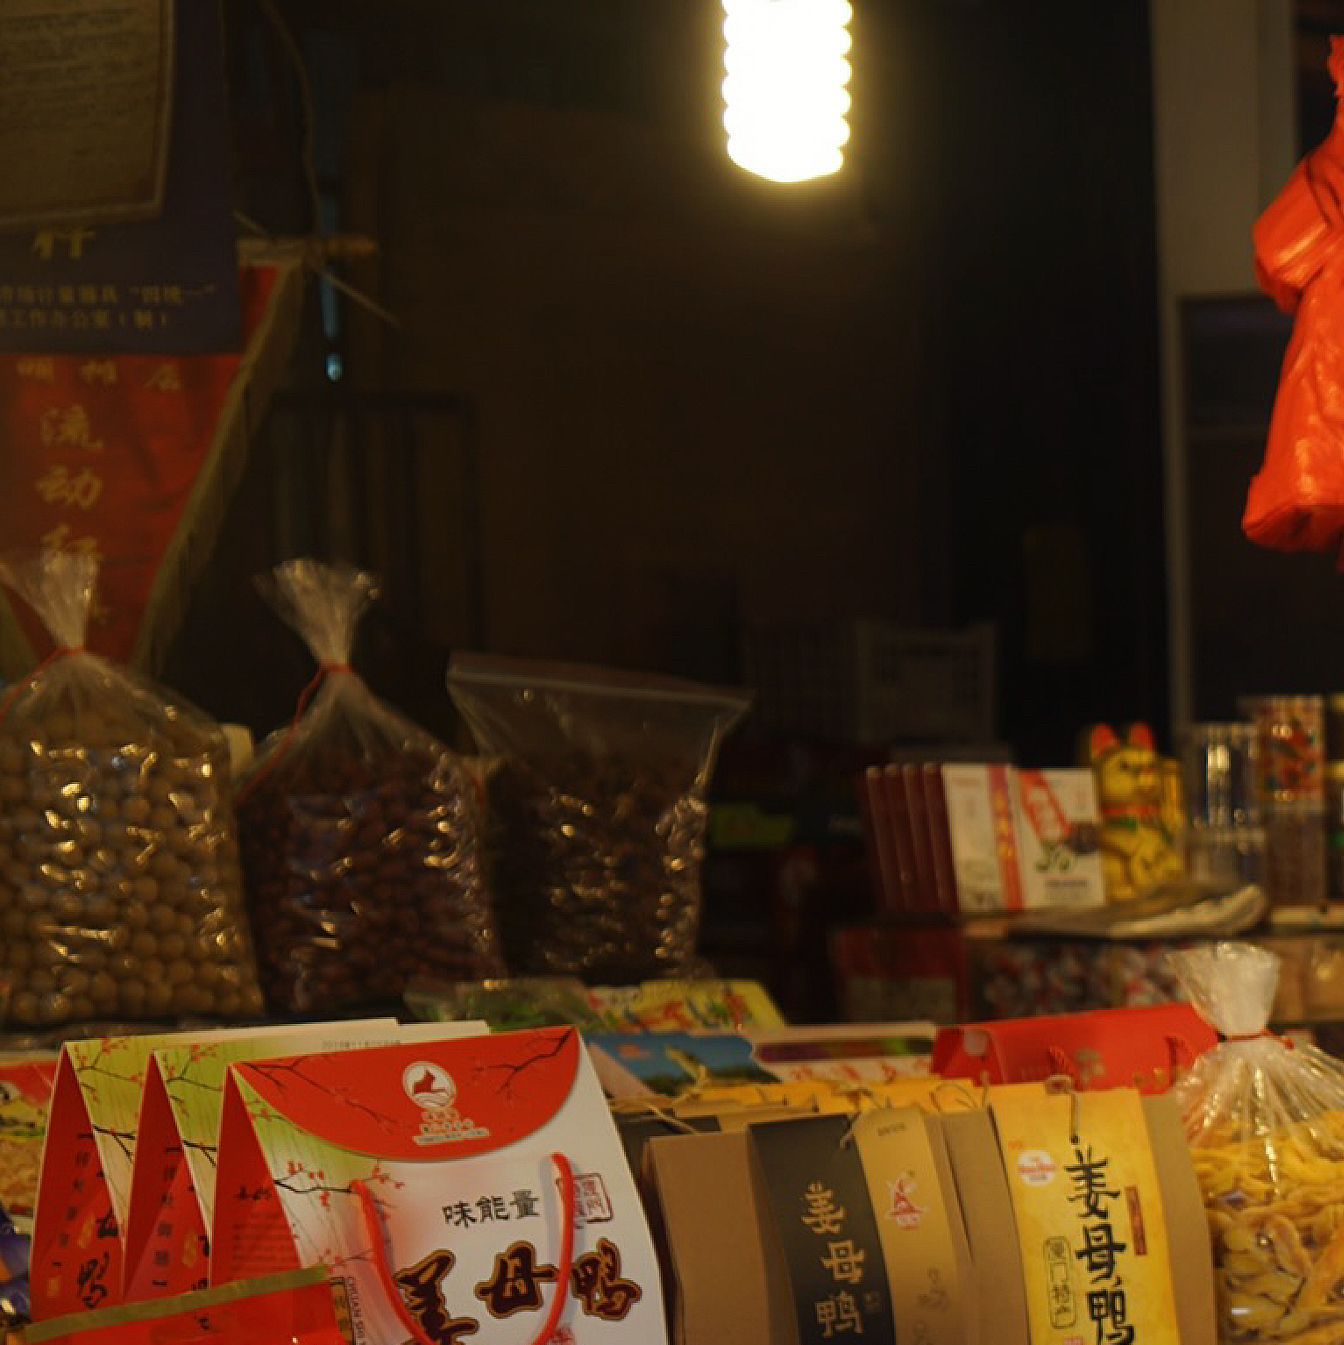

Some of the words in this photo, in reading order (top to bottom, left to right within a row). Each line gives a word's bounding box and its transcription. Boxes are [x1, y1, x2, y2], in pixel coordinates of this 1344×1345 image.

[441, 1187, 542, 1229] 味能量
[802, 1180, 866, 1340] 姜母鸭
